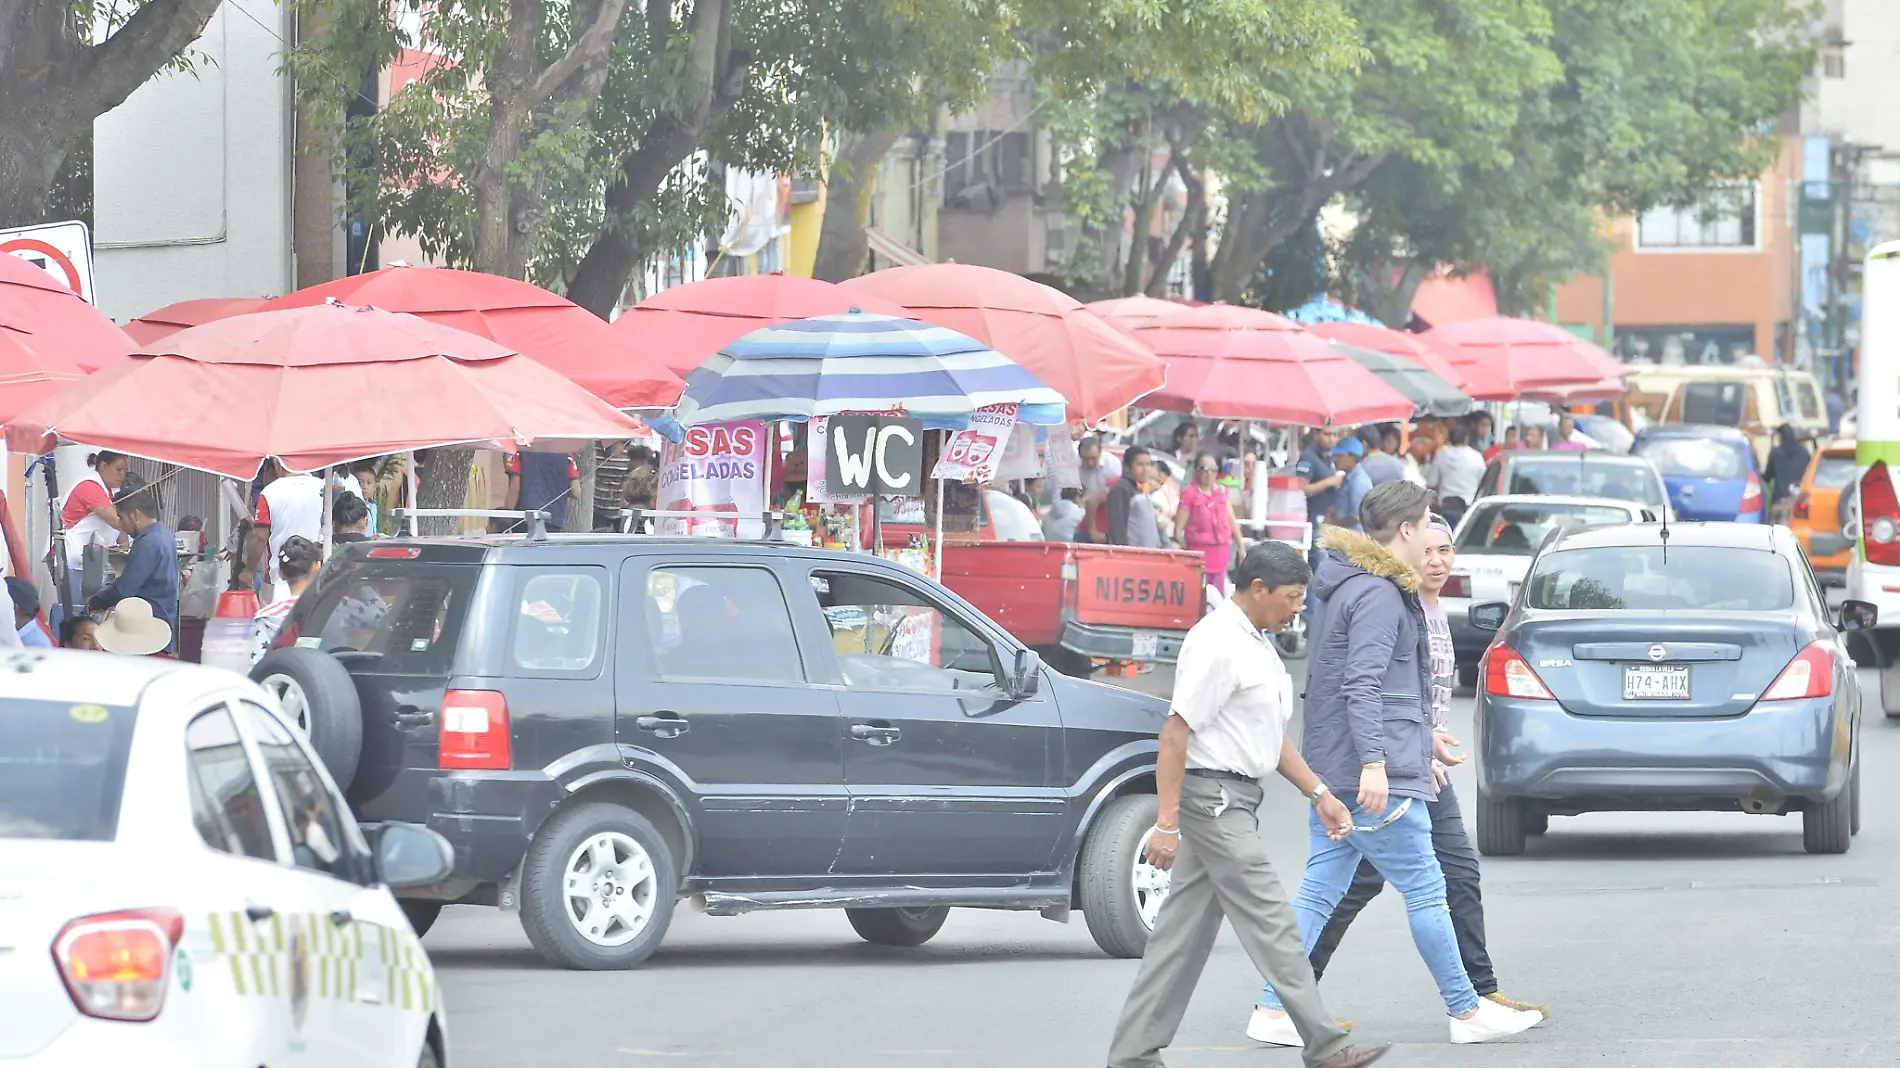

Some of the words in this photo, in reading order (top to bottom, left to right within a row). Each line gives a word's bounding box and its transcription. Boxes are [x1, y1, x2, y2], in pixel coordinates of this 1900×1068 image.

[974, 402, 1018, 416] ESAS
[833, 425, 915, 489] WC
[1095, 576, 1185, 606] NISSAN
[1627, 675, 1687, 691] H74-AHX
